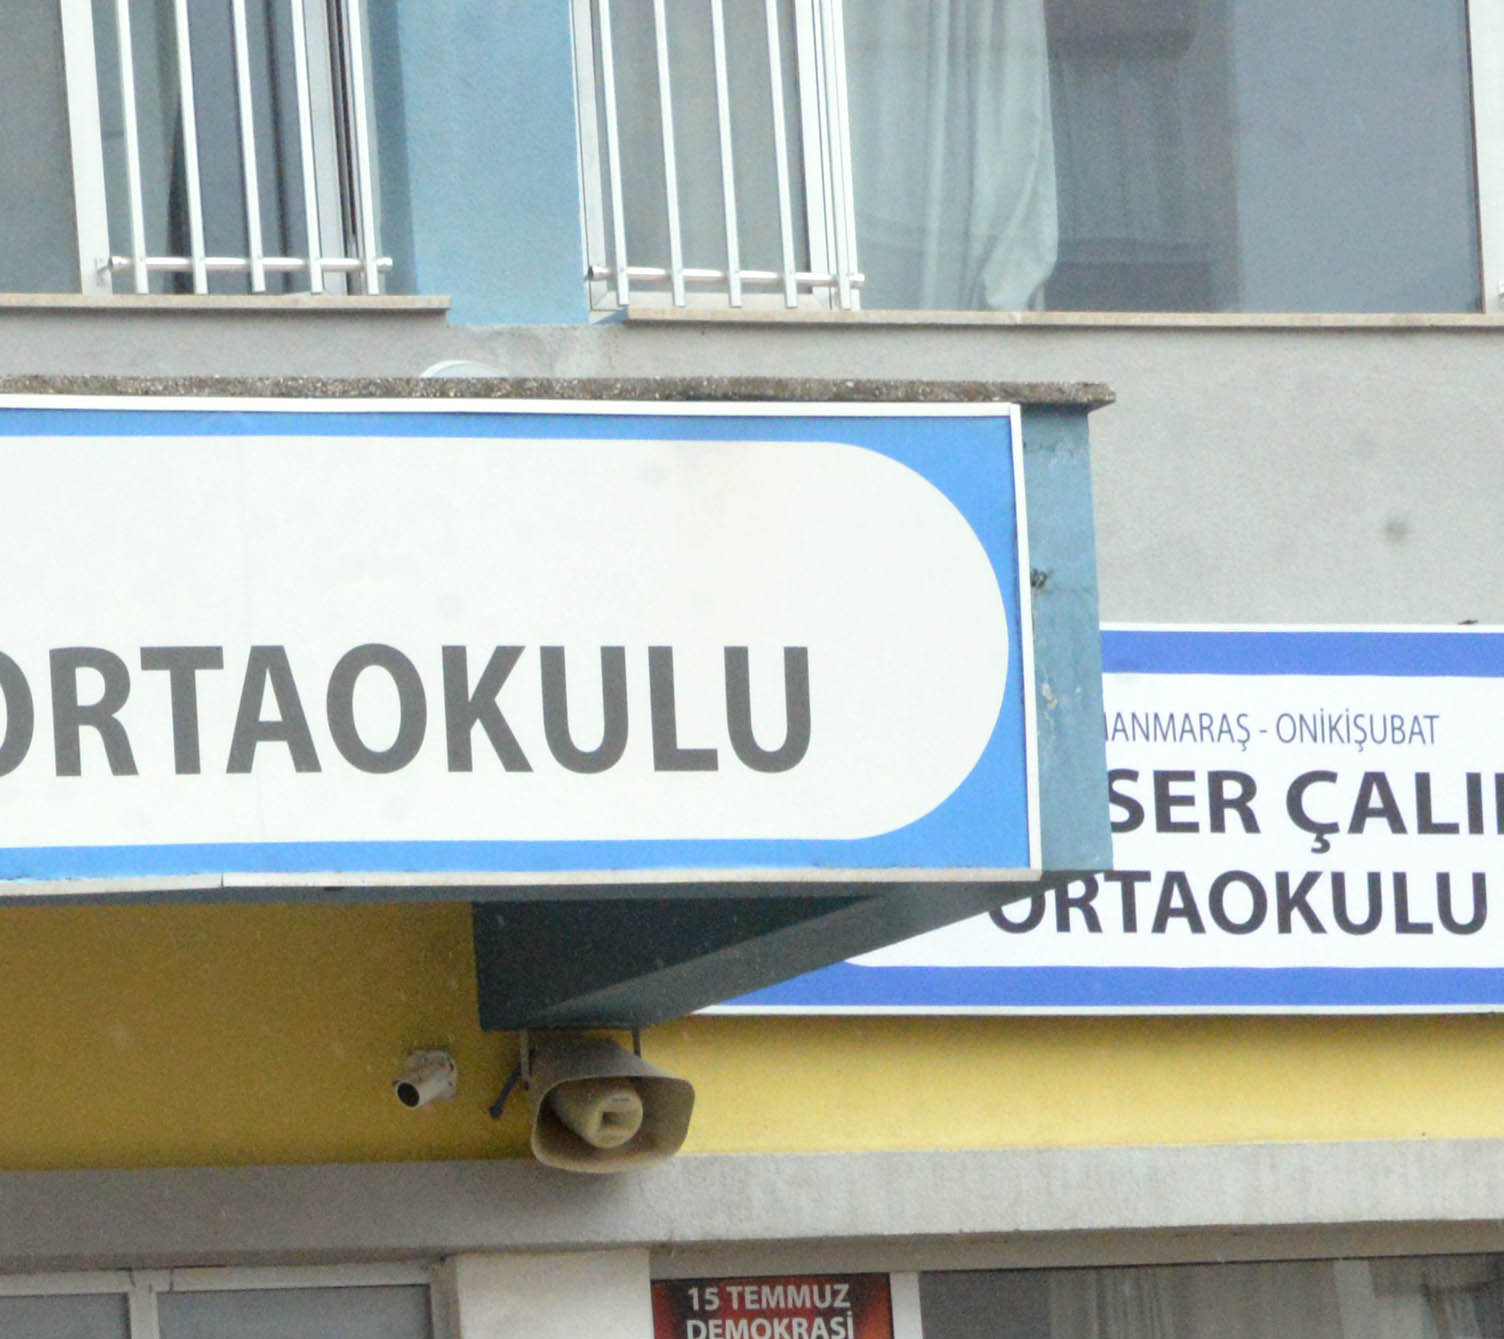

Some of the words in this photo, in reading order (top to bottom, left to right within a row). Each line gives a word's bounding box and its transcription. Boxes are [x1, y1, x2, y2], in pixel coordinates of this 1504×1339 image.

[1275, 707, 1441, 754] ONİKİŞUBAT
[687, 1286, 720, 1311] 15
[726, 1283, 852, 1311] TEMMUZ
